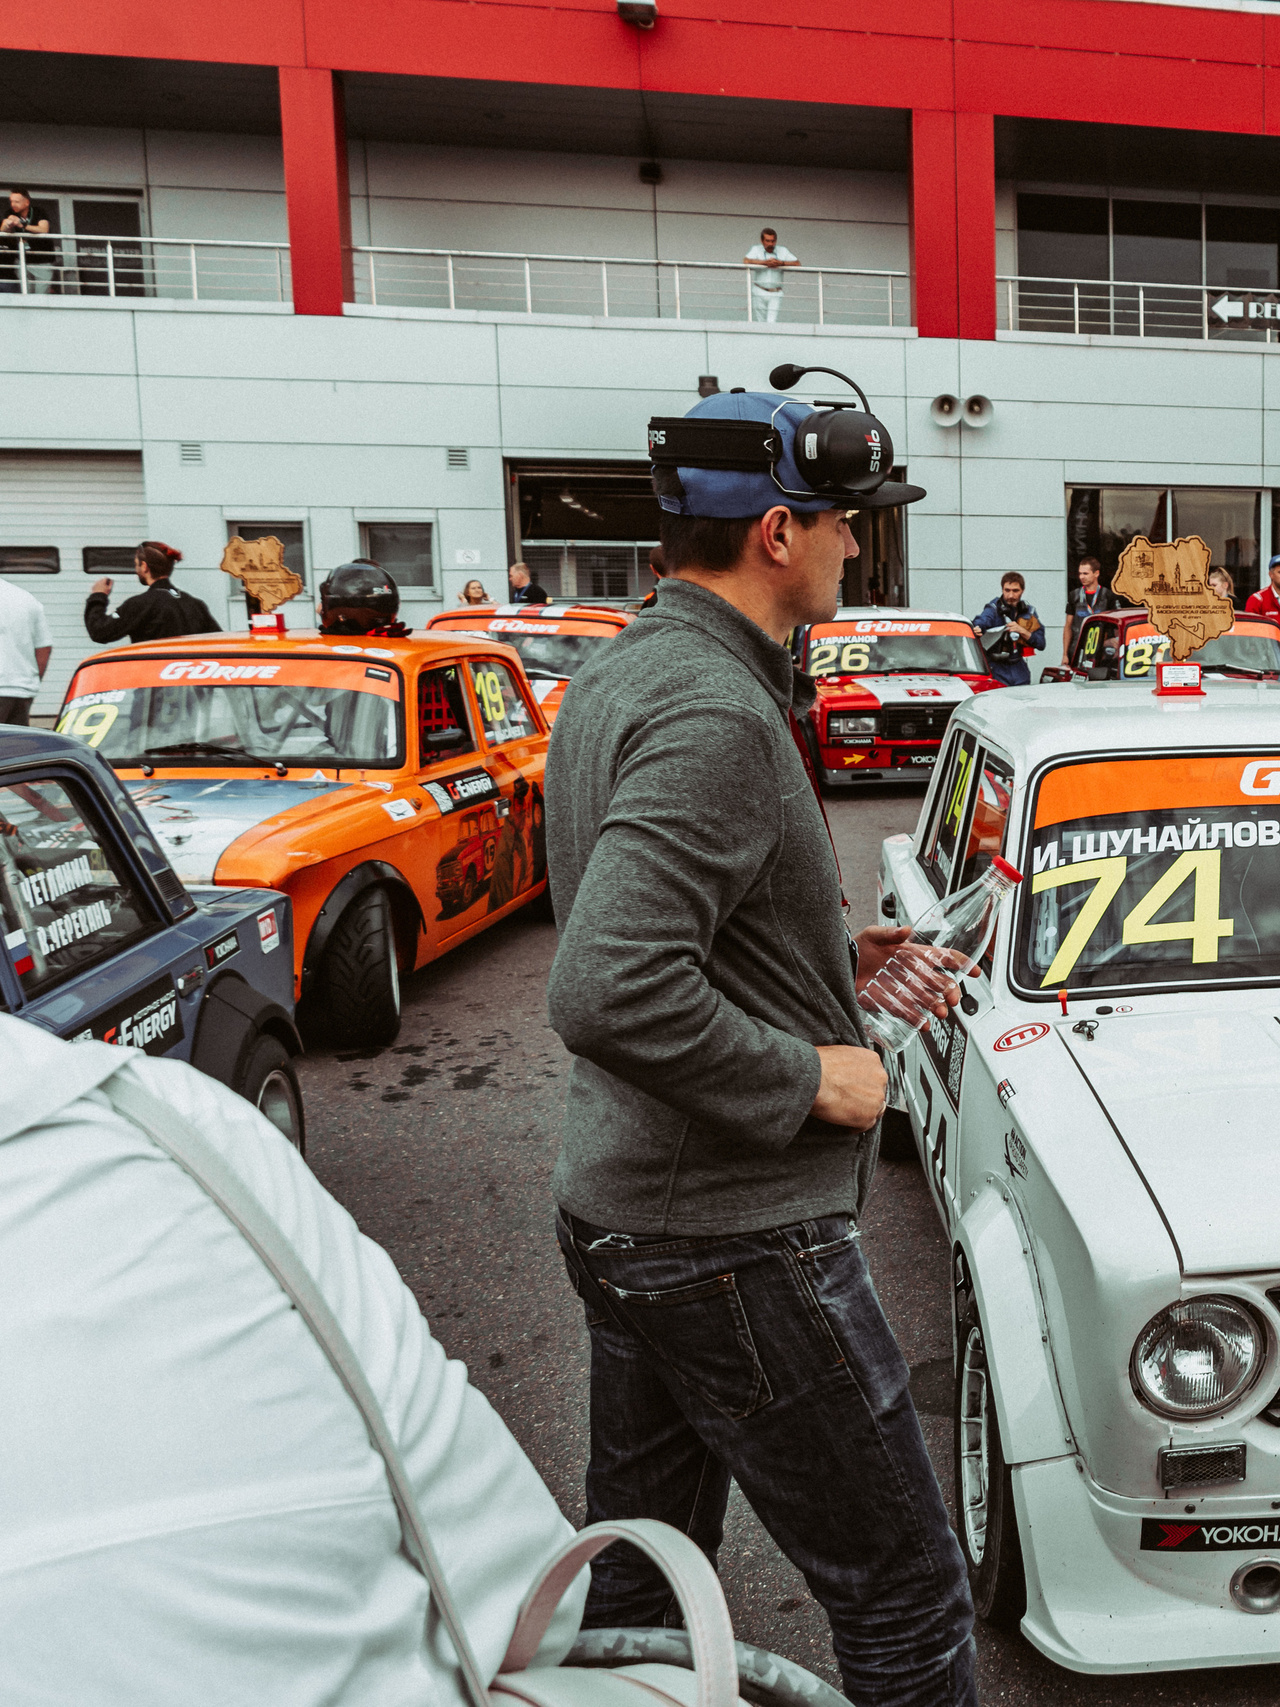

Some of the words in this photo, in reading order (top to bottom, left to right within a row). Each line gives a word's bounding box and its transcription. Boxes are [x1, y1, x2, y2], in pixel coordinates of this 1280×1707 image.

[865, 429, 882, 473] Stilo
[855, 620, 931, 633] G-DRIVE
[1085, 626, 1100, 655] 80
[159, 661, 281, 681] G-DRIVE
[809, 643, 870, 677] 26
[475, 671, 506, 722] 19
[910, 755, 938, 764] YOKOH
[1072, 817, 1280, 863] ШУНАЙЛОВ
[1031, 849, 1234, 988] 74
